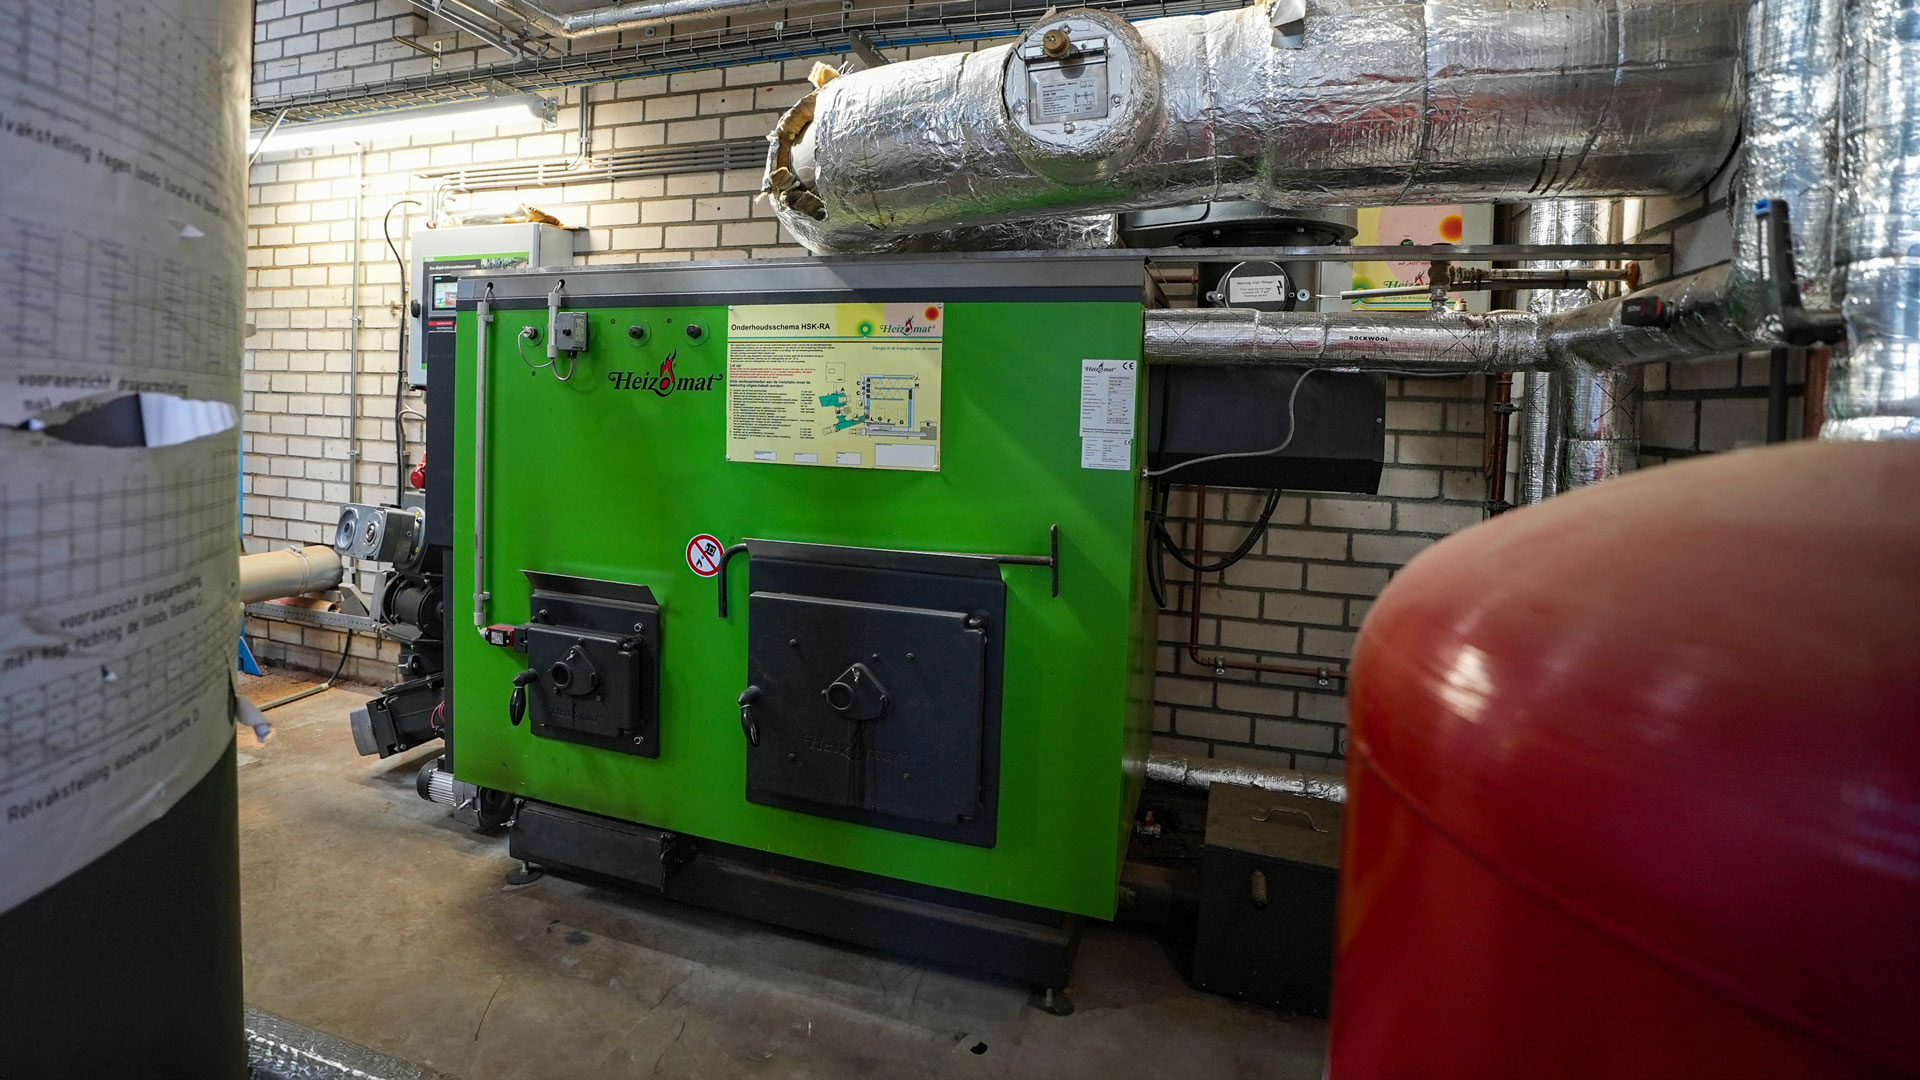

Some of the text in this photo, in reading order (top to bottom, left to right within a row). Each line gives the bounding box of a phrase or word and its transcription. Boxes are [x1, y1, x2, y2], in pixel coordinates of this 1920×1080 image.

[98, 148, 131, 173] tegen
[731, 323, 800, 332] Onderhoudsschema
[880, 315, 936, 336] Heizomat
[607, 348, 724, 397] Heizomat
[1084, 362, 1117, 374] Heizomat
[17, 374, 111, 390] vooraanzicht
[60, 597, 138, 629] vooraanzicht
[75, 626, 123, 649] richting
[127, 620, 140, 635] de
[7, 765, 111, 824] Rolvakstelling
